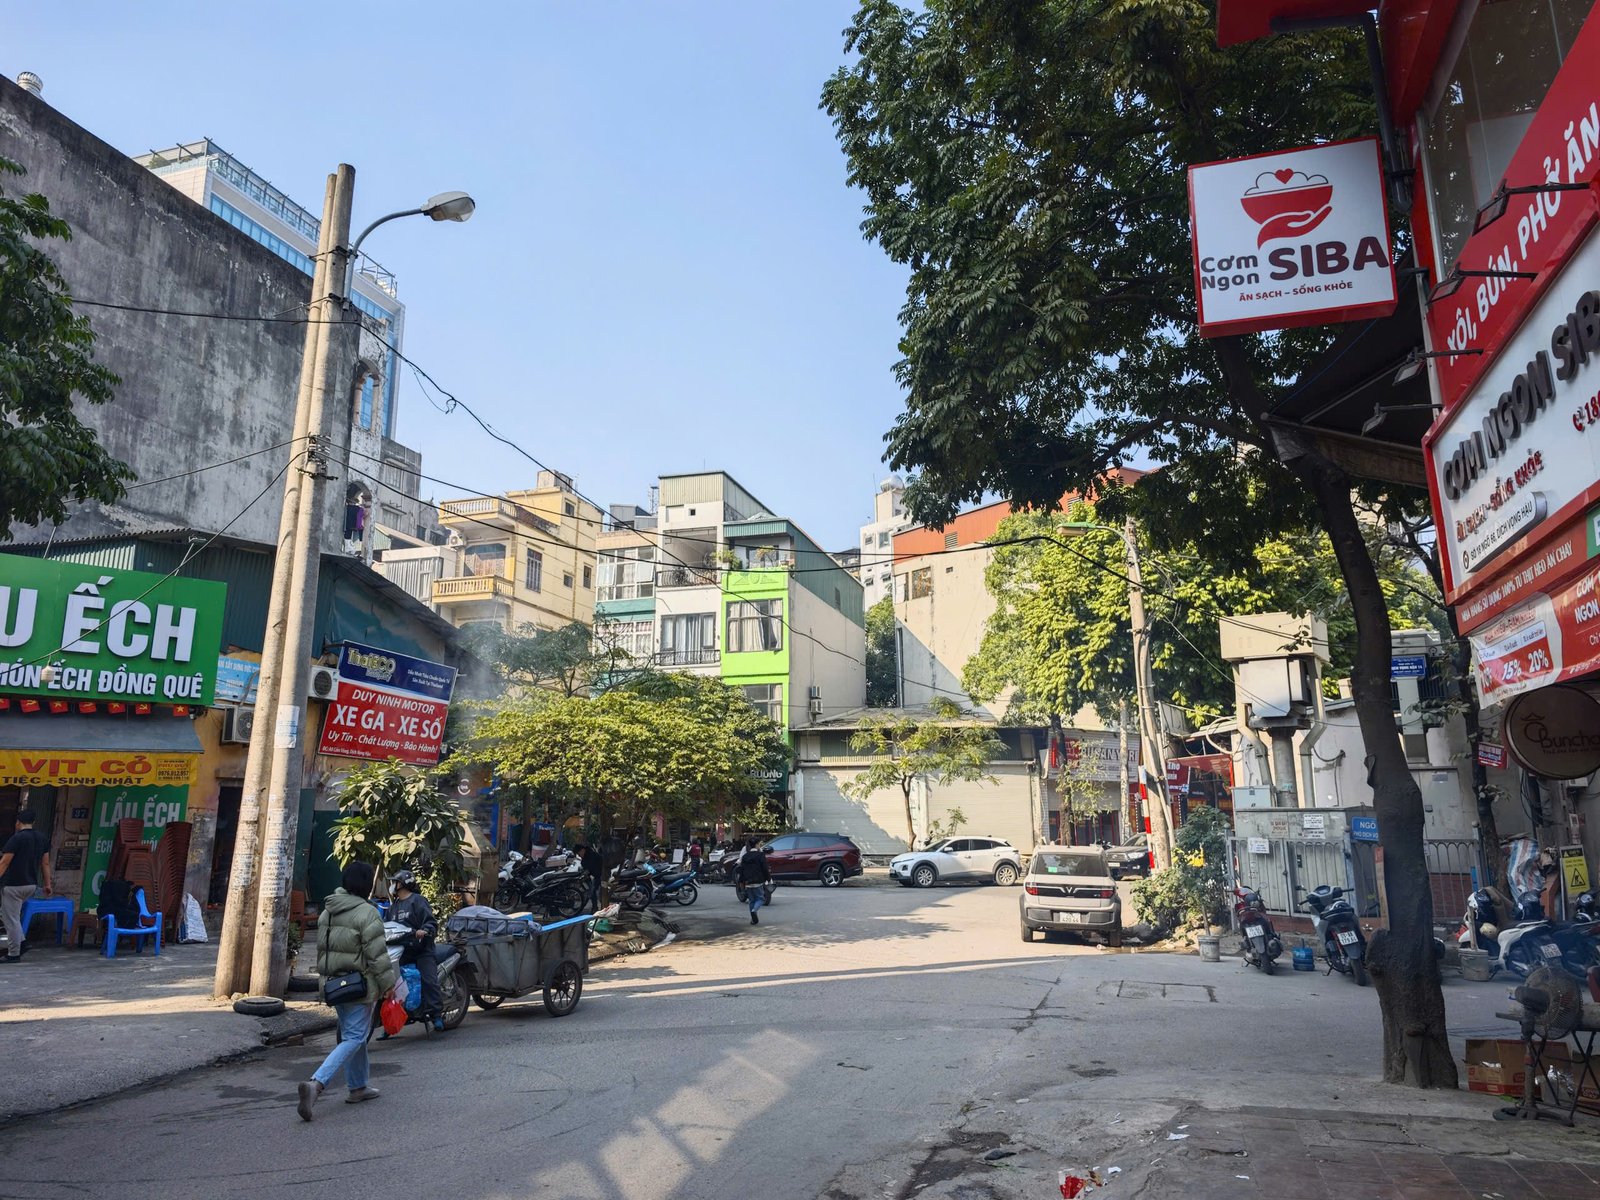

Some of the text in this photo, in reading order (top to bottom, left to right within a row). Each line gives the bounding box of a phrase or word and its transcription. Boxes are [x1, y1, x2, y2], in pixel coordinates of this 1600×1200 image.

[1200, 254, 1258, 273] Cơm
[1268, 235, 1390, 281] SIBA
[1201, 272, 1260, 292] Ngon
[1239, 292, 1254, 302] ĂN
[1256, 290, 1282, 301] SẠCH
[1292, 284, 1322, 296] SỐNG
[1324, 280, 1354, 292] KHỎE
[1482, 349, 1556, 460] NGON
[1534, 558, 1547, 578] HEO
[1555, 540, 1573, 562] CHAY
[61, 576, 197, 662] ẾCH
[1574, 598, 1599, 624] NGON
[1502, 659, 1522, 681] 15%
[1528, 648, 1549, 673] 20%
[98, 663, 157, 696] ĐỒNG
[162, 672, 204, 700] QUÊ
[352, 689, 435, 715] DUY NINH MOTOR
[332, 704, 358, 727] XE
[361, 709, 384, 731] GA
[398, 715, 420, 737] XE
[420, 716, 443, 740] SỐ
[328, 730, 340, 742] Uy
[341, 732, 353, 742] Tín
[358, 733, 375, 746] Chất
[376, 738, 399, 750] Lượng
[404, 740, 417, 751] Bảo
[418, 741, 438, 753] Hành!
[2, 775, 40, 785] TIỆC
[58, 776, 96, 784] SINH
[101, 776, 144, 785] NHẬT
[20, 755, 152, 777] VỊT CỎ
[143, 794, 181, 827] ẾCH
